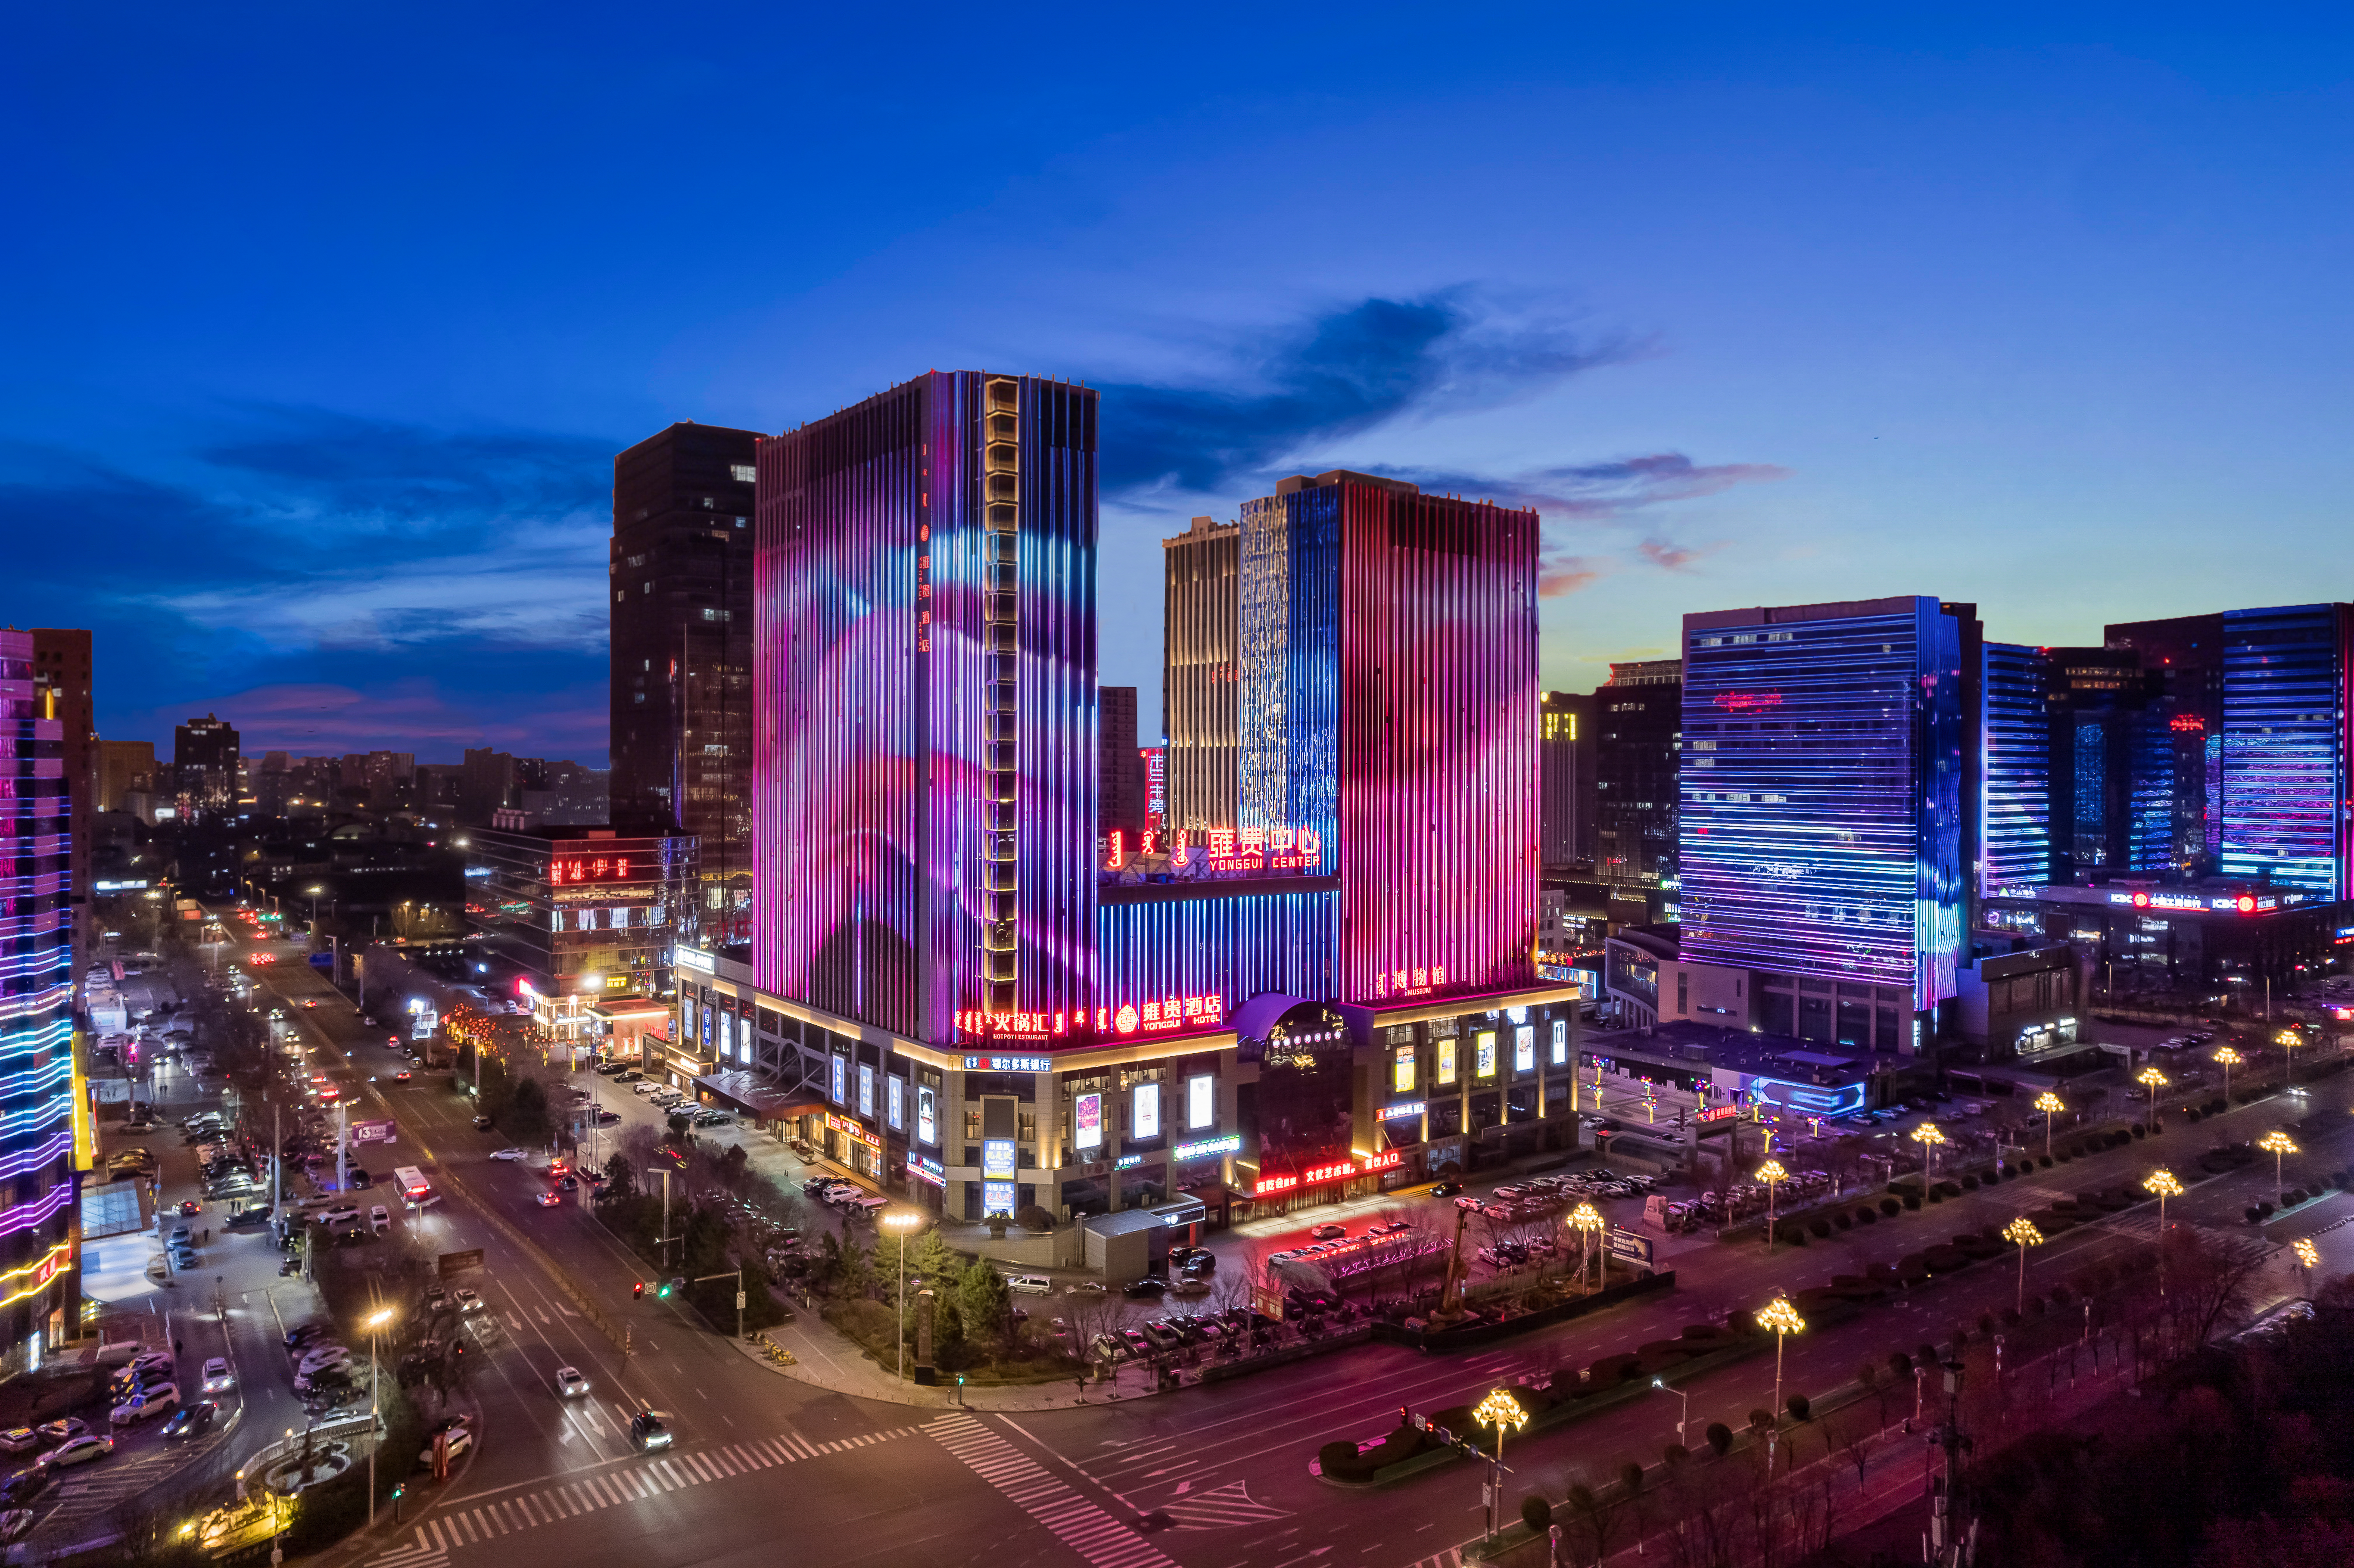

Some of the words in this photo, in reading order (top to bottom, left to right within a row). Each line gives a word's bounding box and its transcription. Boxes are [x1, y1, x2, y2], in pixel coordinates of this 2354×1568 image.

[1208, 825, 1320, 858] 雍贵中心
[1210, 858, 1263, 871] YONGGUI
[1272, 856, 1320, 868] CENTER
[2111, 893, 2133, 903] ICBC
[2212, 899, 2238, 908] ICBC
[1394, 965, 1445, 989] 博物馆
[1407, 987, 1431, 996] MUSEUM
[1143, 996, 1221, 1022] 雍贵酒店
[994, 1012, 1049, 1032] 火锅汇
[1144, 1019, 1180, 1031] YONGGUI
[1193, 1014, 1220, 1025] HOTEL
[991, 1057, 1051, 1072] 鄂尔多斯银行
[1365, 1153, 1398, 1170] 餐饮入口
